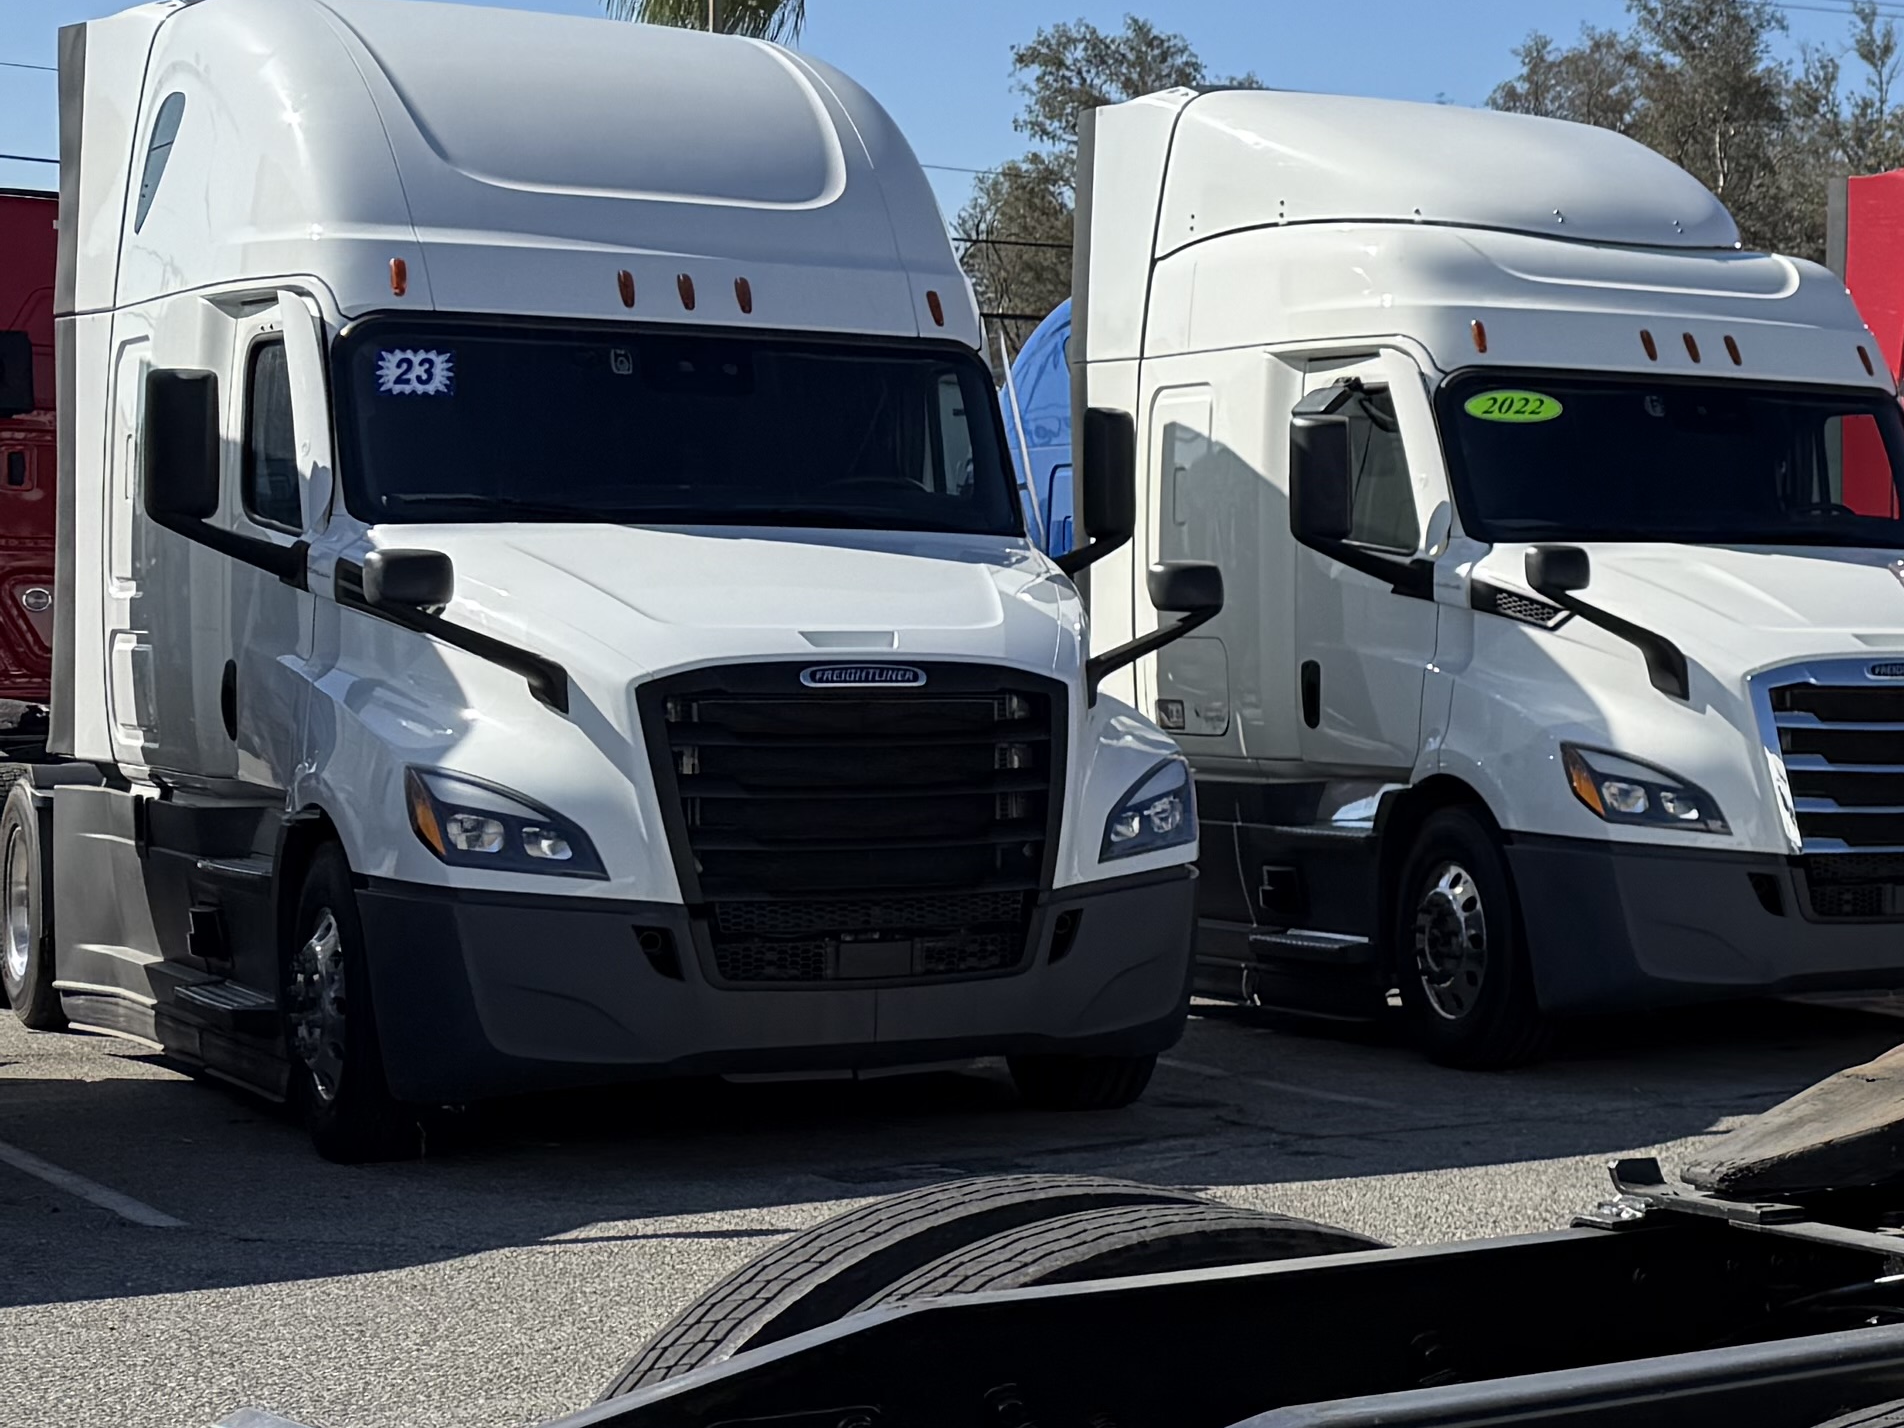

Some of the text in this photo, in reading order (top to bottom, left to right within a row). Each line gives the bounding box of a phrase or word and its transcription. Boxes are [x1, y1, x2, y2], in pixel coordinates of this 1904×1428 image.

[393, 357, 436, 386] 23
[1481, 396, 1545, 416] 2022
[815, 668, 914, 682] FREIGHTLINER
